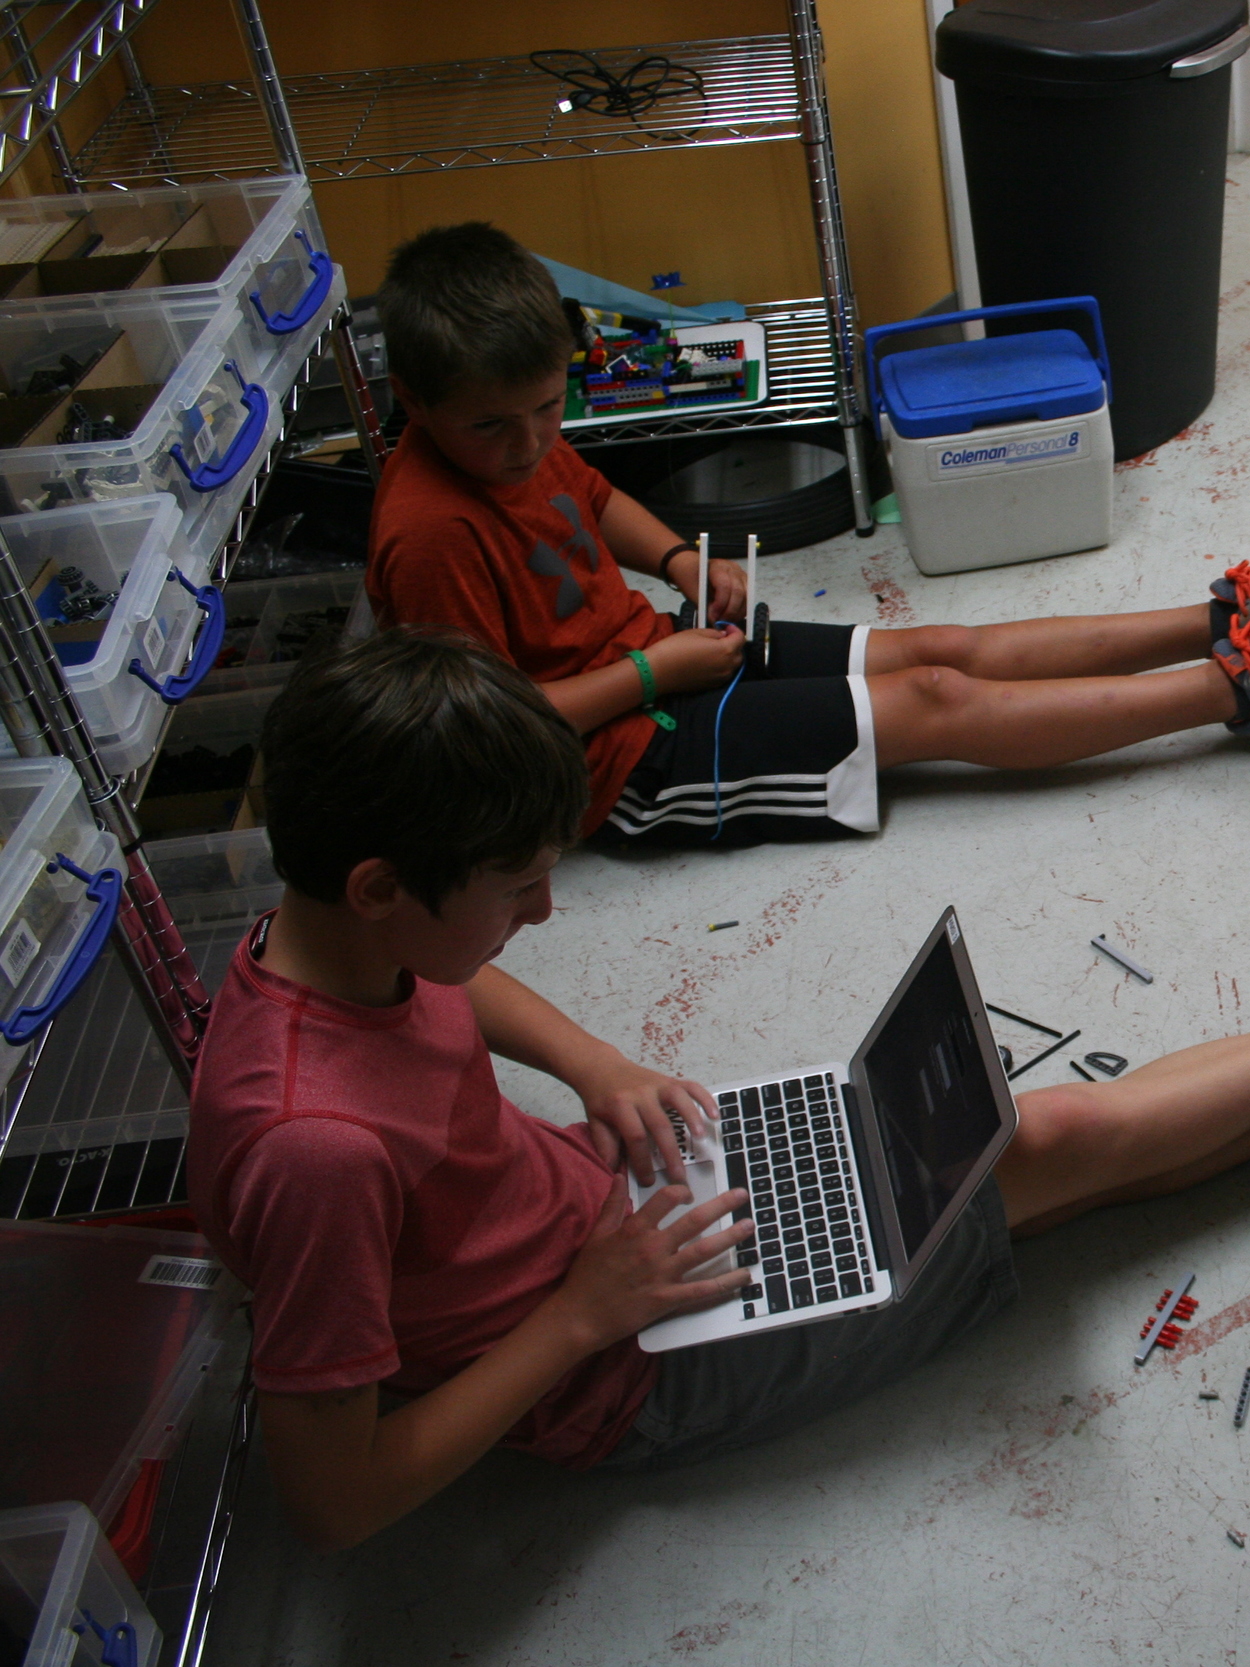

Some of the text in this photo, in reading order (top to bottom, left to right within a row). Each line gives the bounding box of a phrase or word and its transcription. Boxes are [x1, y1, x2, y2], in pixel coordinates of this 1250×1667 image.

[941, 431, 1079, 466] Coleman Personal 8
